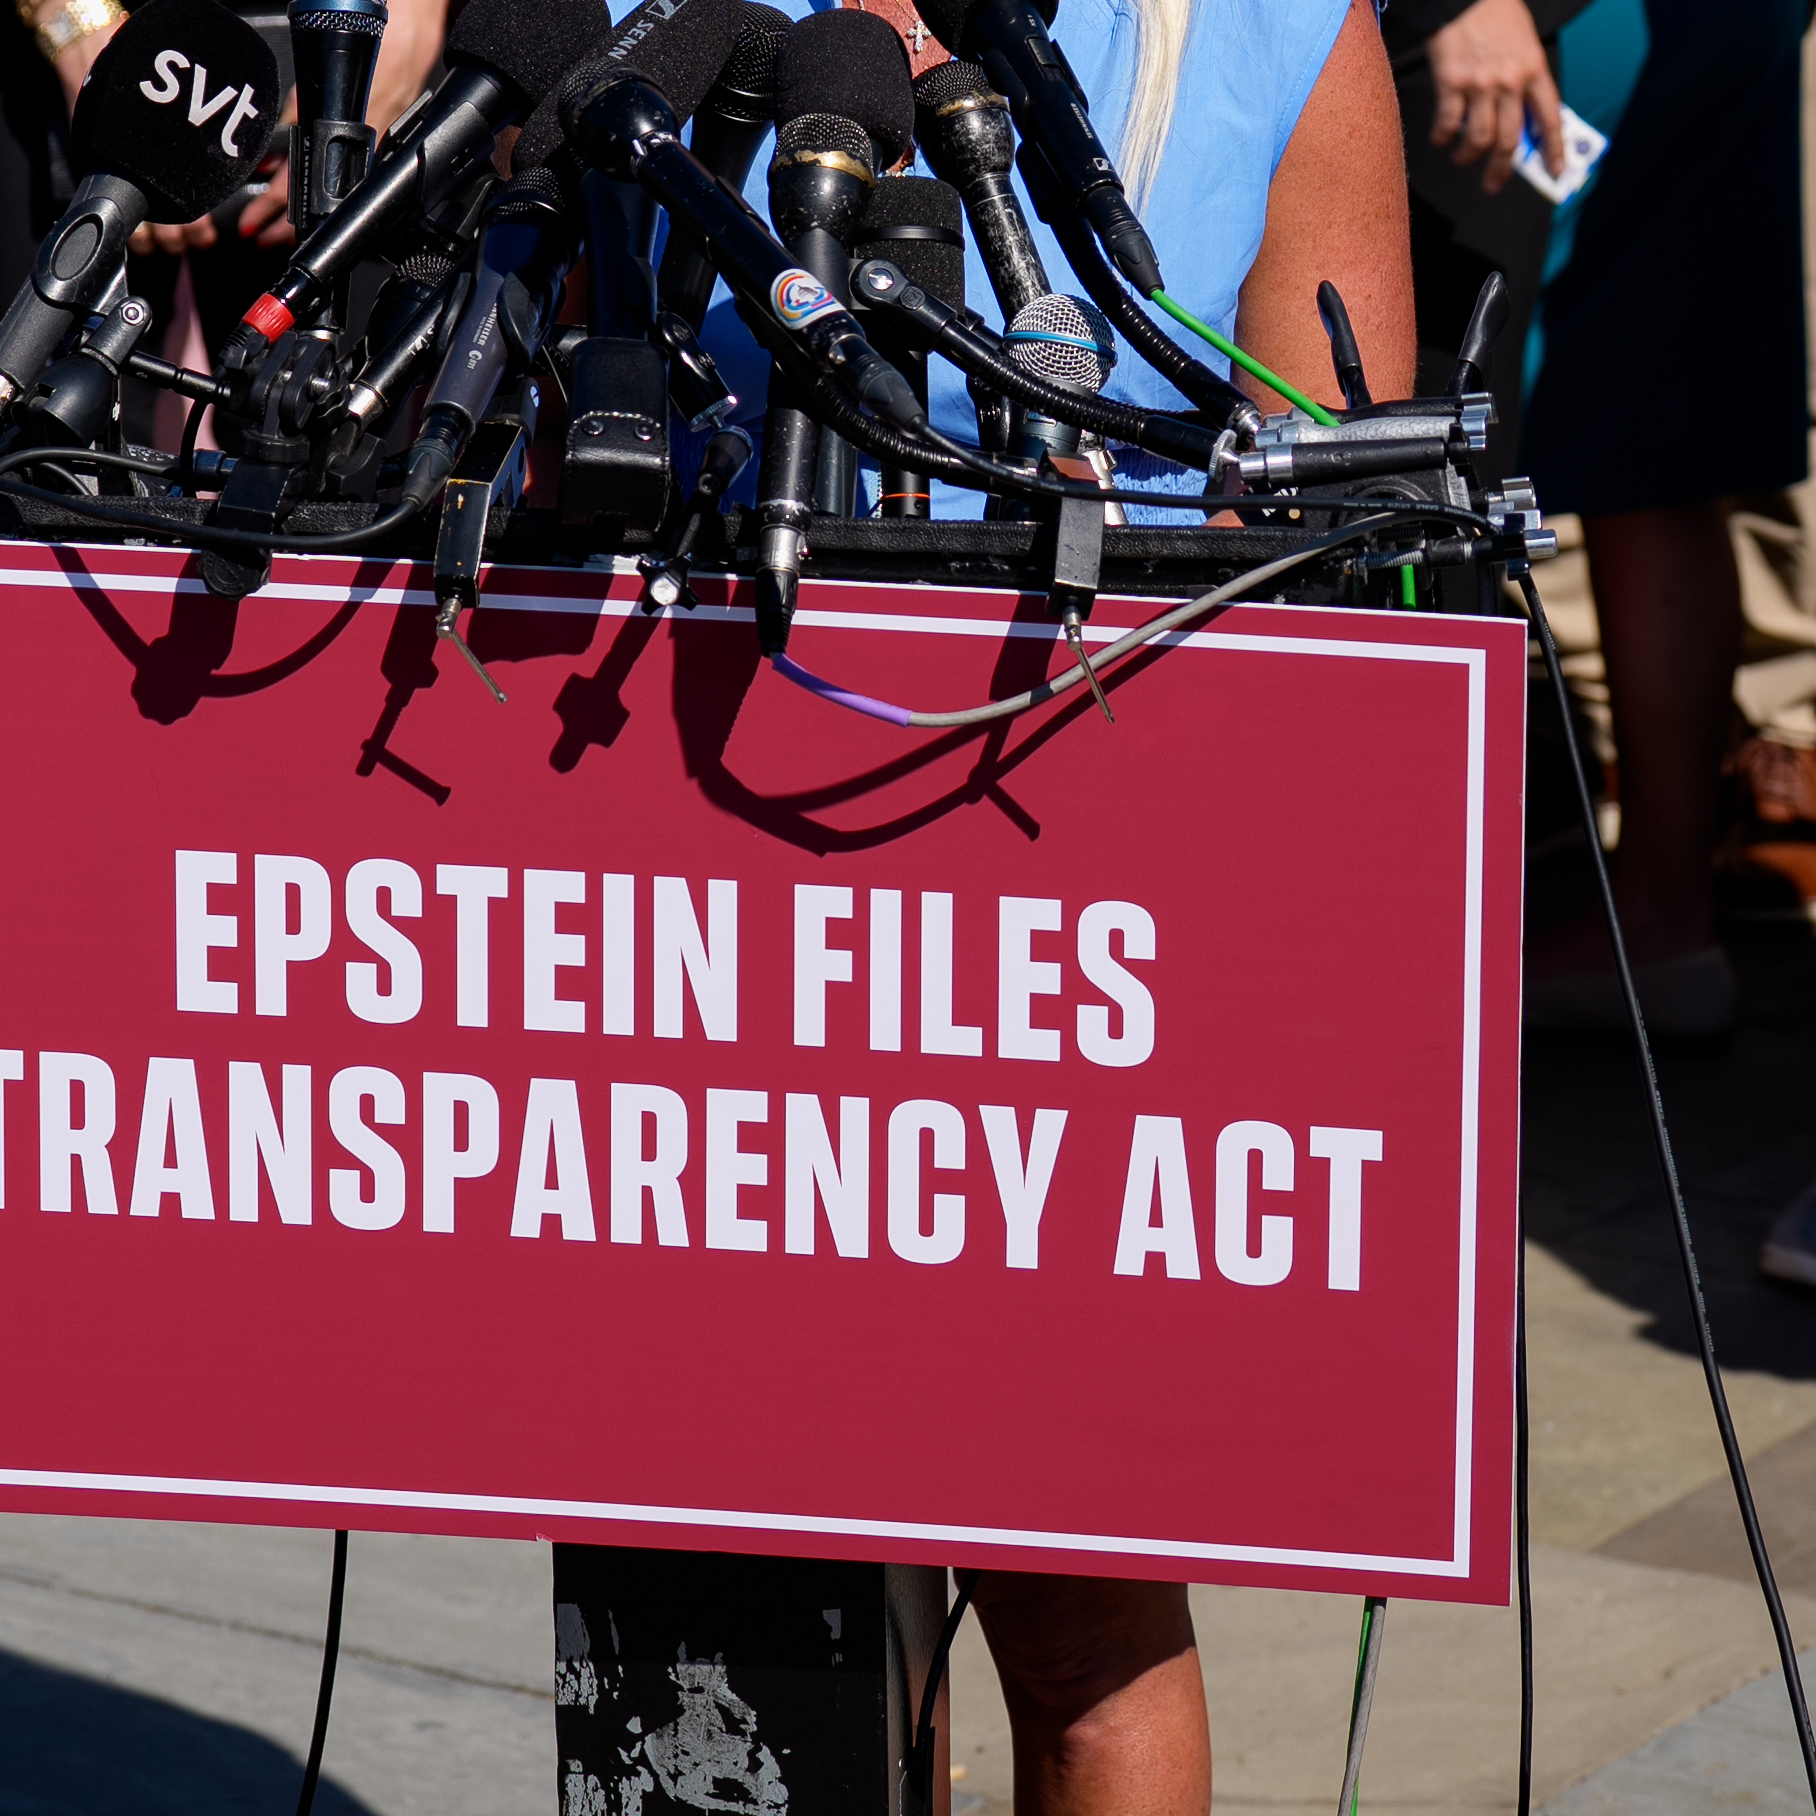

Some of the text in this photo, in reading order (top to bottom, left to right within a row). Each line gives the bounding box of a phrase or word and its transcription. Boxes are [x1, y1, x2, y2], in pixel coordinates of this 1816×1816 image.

[139, 49, 259, 158] svt
[1415, 503, 1439, 511] CABLE
[176, 850, 1155, 1067] EPSTEIN FILES
[1114, 1115, 1382, 1291] ACT
